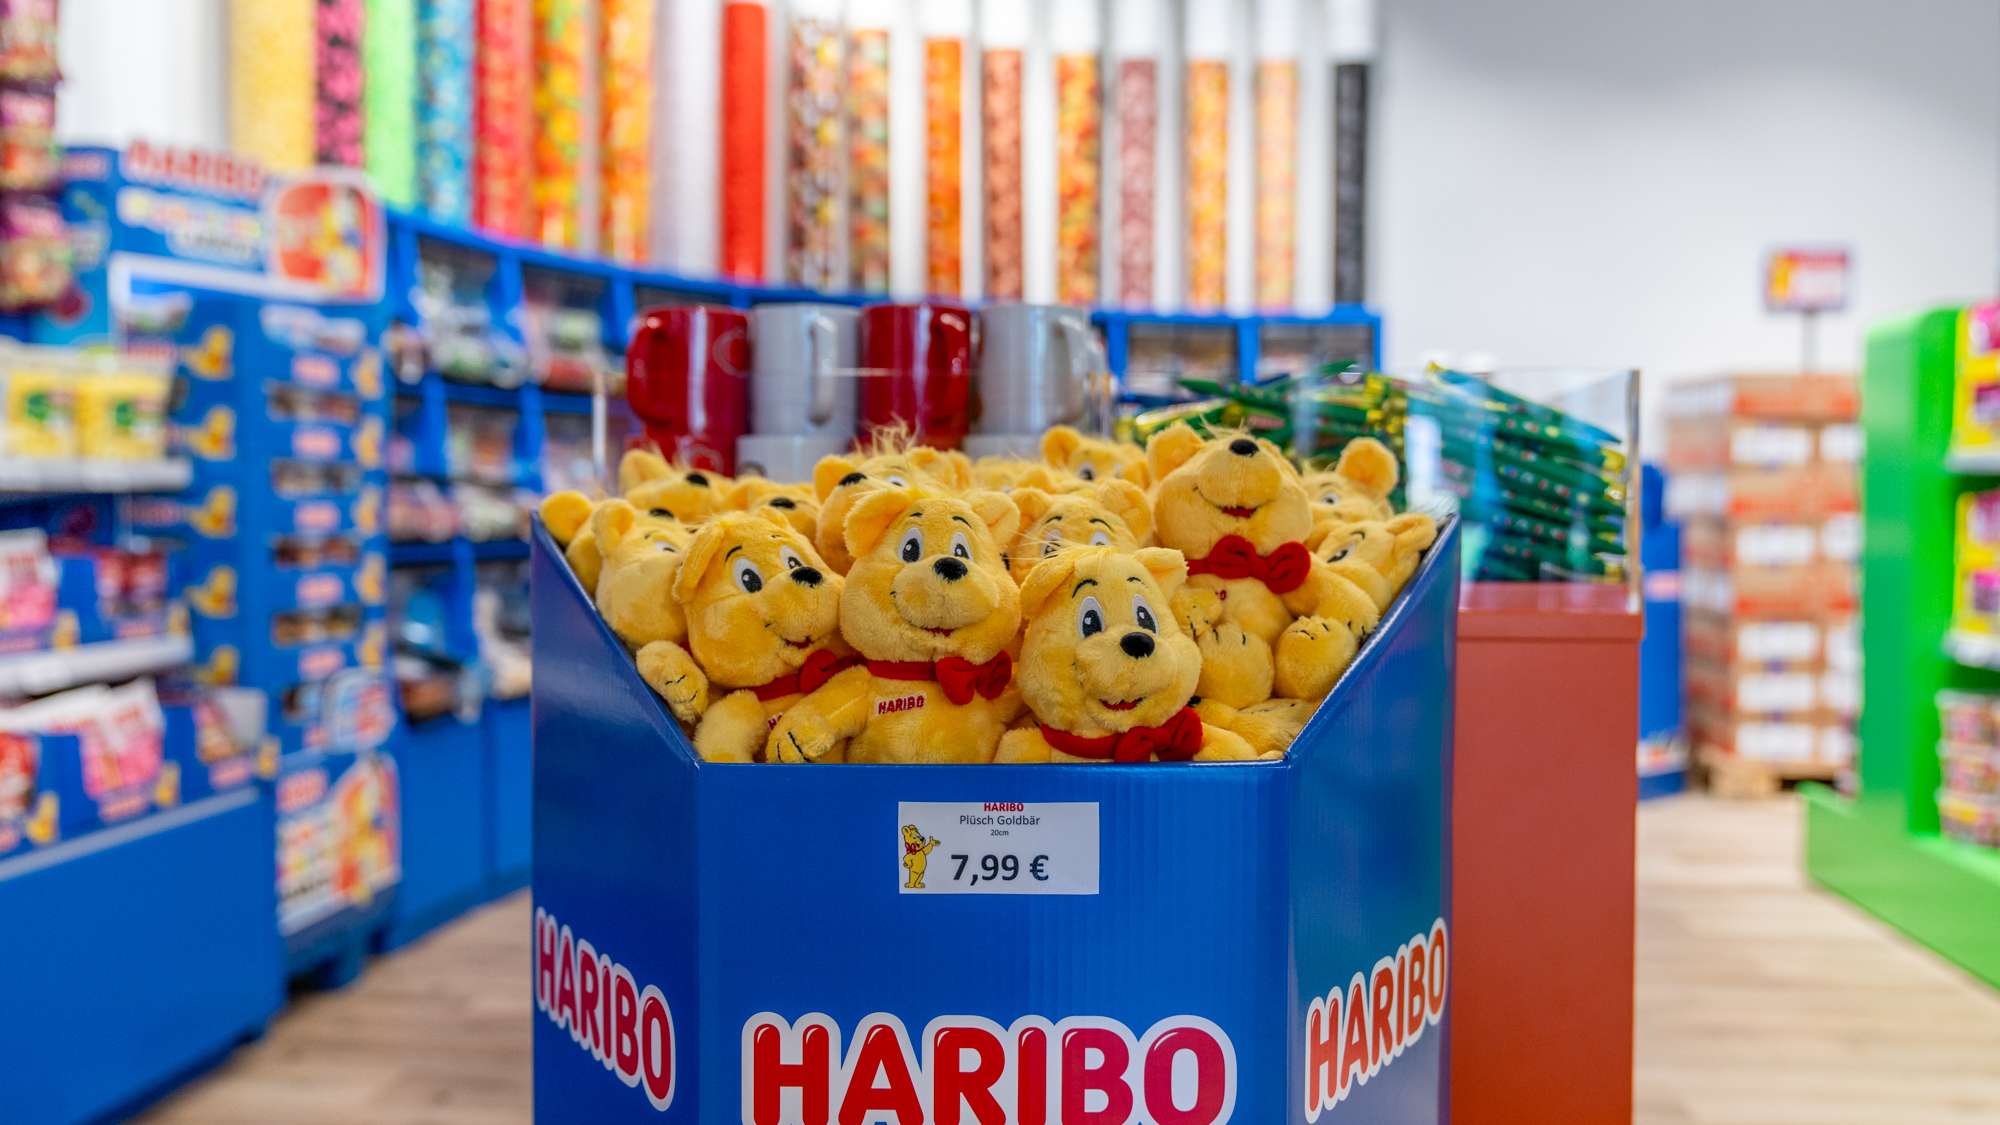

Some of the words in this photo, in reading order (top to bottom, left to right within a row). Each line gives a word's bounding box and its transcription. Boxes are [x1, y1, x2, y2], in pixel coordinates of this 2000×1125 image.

[878, 694, 925, 715] HARIBO
[959, 815, 994, 825] Plüsch
[997, 815, 1041, 825] Goldbär
[984, 803, 1024, 812] HARIBO
[950, 854, 1020, 887] 7,99
[1029, 854, 1049, 881] €
[536, 914, 673, 1102] HARIBO
[1308, 927, 1446, 1112] HARIBO
[752, 1022, 1226, 1125] HARIBO
